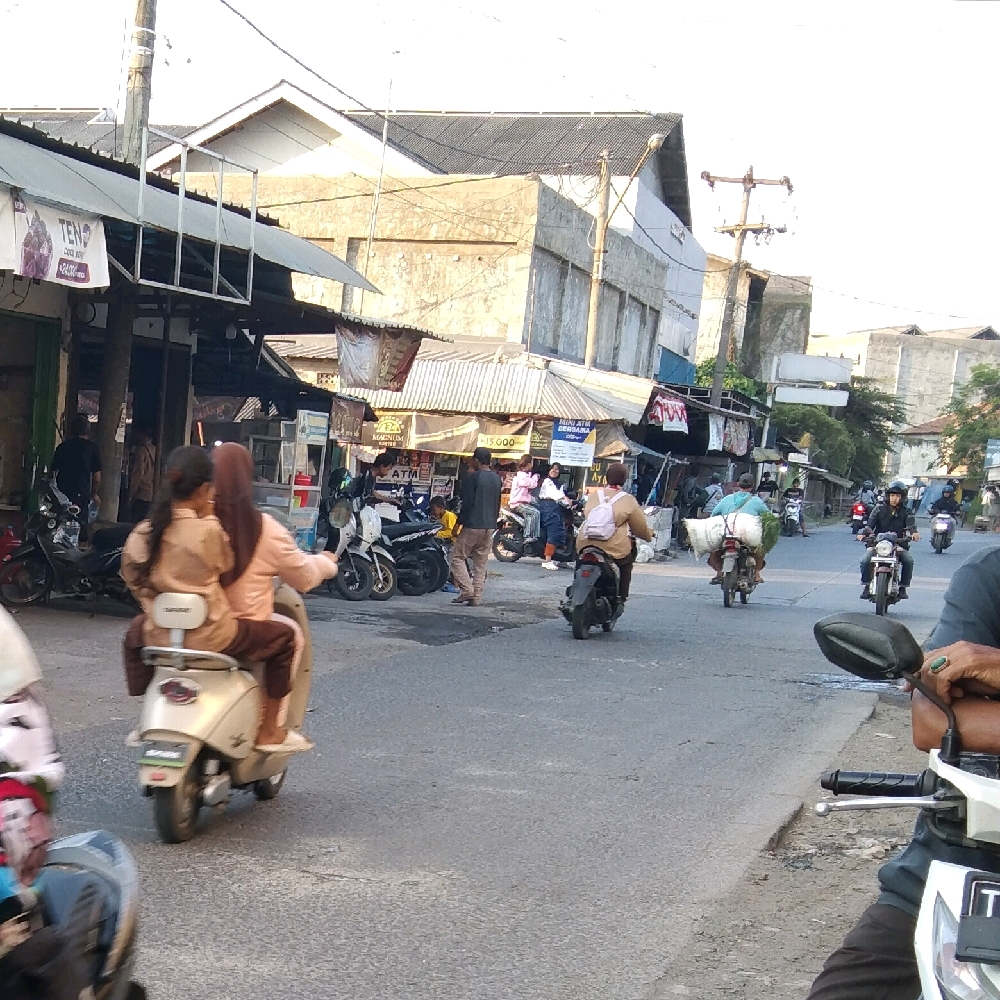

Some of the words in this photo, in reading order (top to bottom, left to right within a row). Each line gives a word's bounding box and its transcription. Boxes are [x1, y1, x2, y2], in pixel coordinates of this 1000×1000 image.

[576, 420, 591, 428] ATM
[372, 434, 404, 442] MAGNUM
[392, 470, 418, 479] ATM
